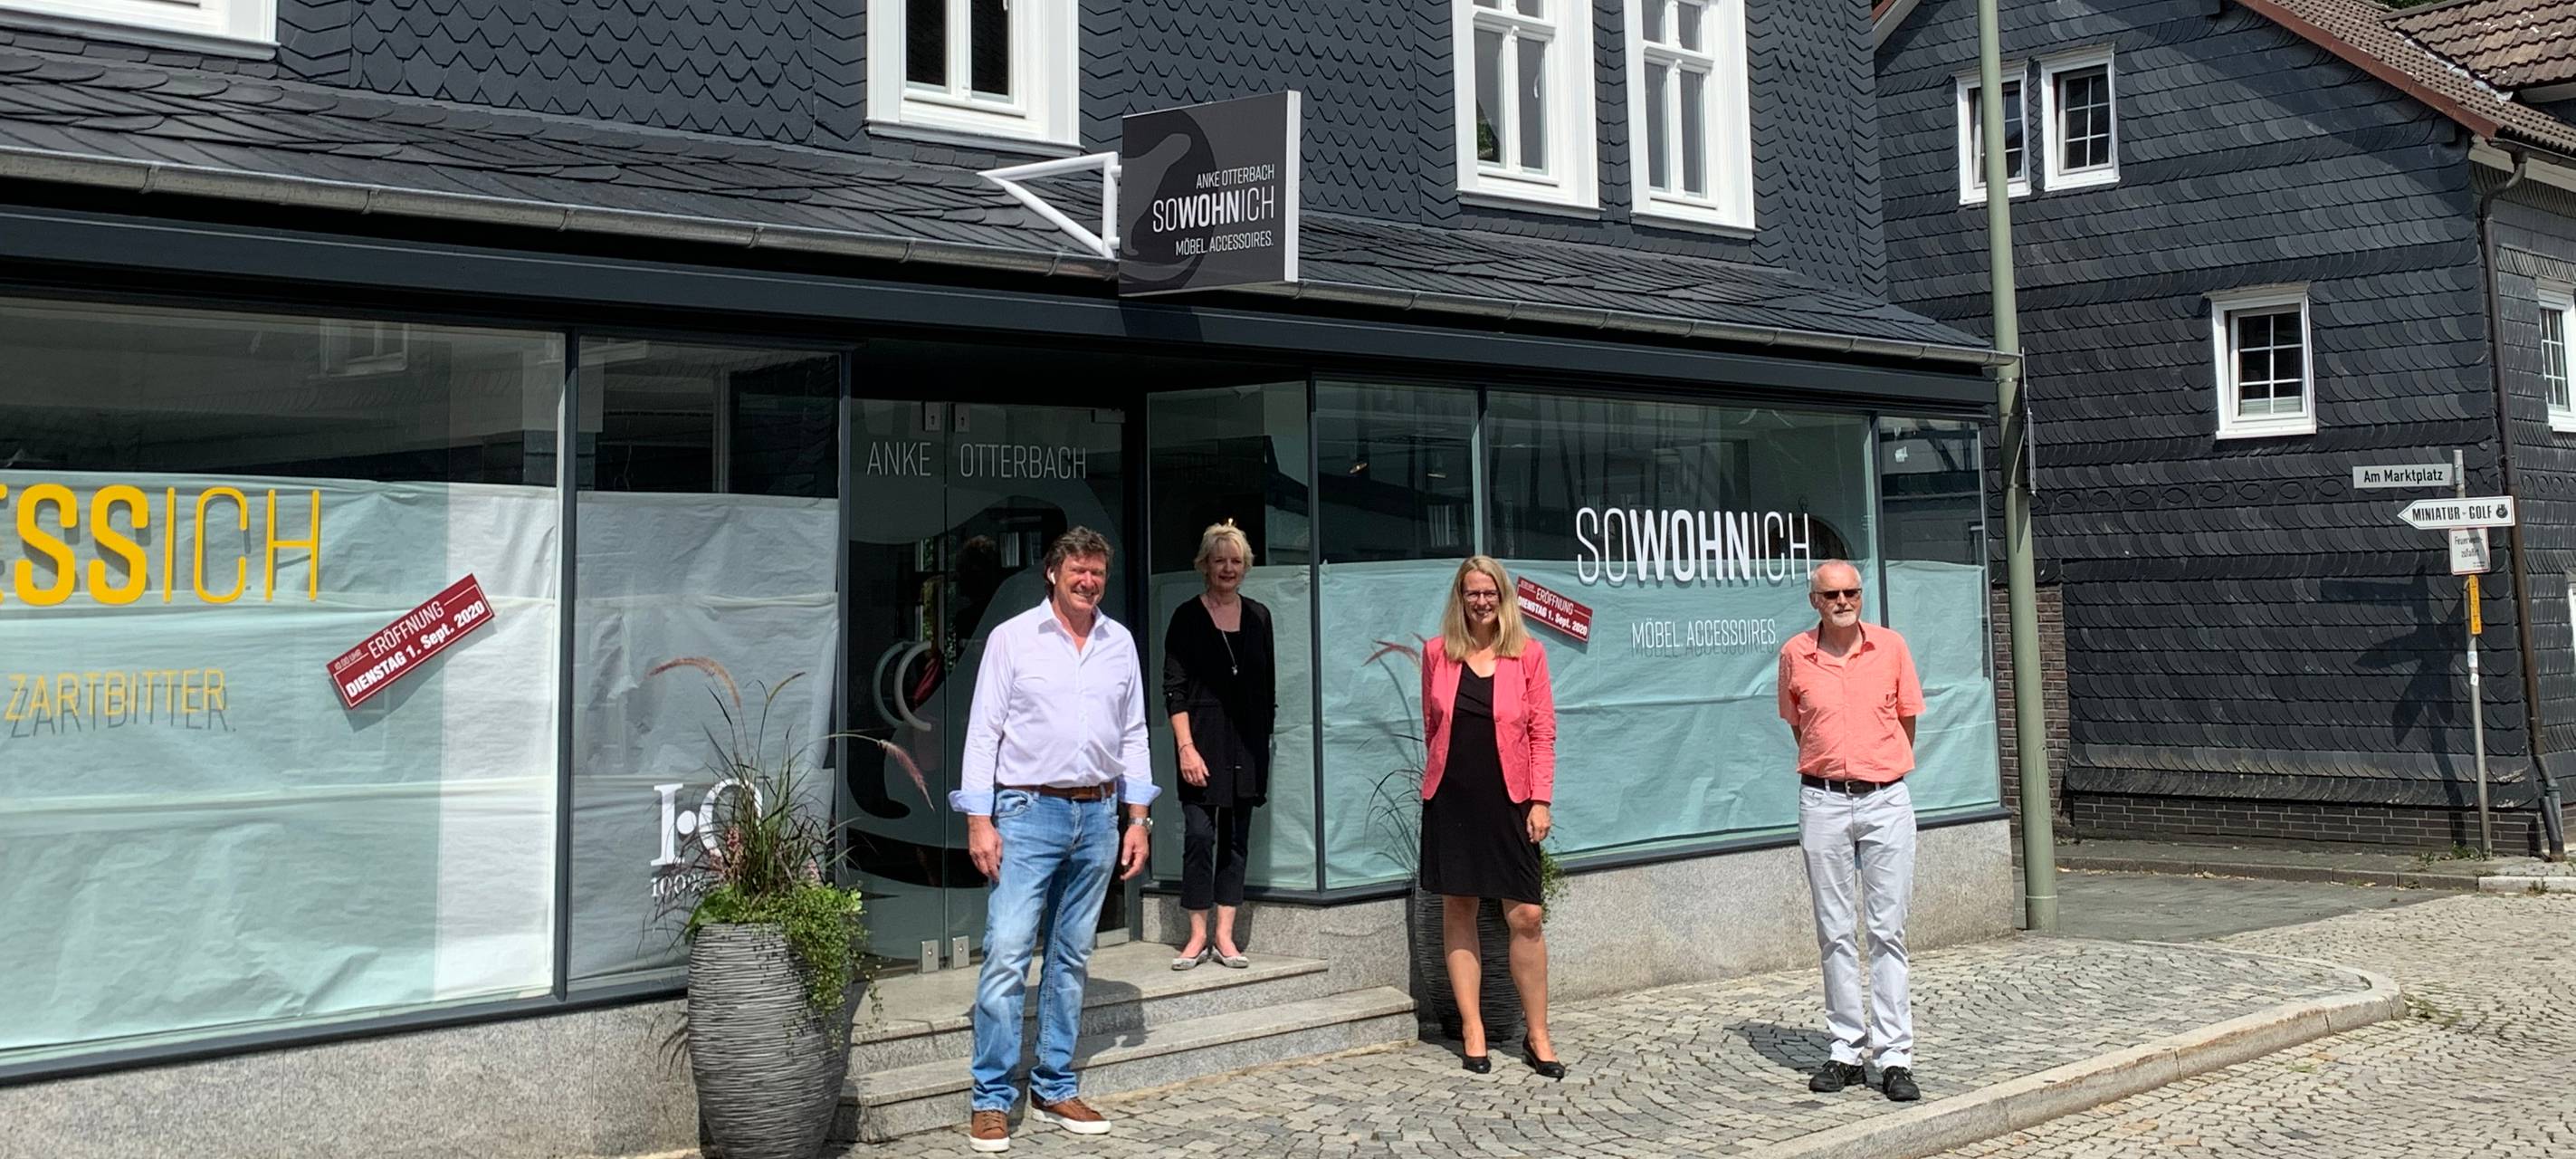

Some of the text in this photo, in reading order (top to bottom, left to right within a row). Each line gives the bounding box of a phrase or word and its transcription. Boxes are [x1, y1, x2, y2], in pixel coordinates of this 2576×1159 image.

[1196, 164, 1274, 189] ANKE OTTERBACH
[1153, 185, 1274, 233] SOWOHNICH
[1176, 230, 1274, 256] MÖBEL. ACCESSOIRES.
[866, 442, 1086, 479] ANKE OTTERBACH
[2363, 468, 2443, 484] Am Marktplatz
[2469, 504, 2492, 520] GOLF
[0, 484, 320, 607] SSICH
[1576, 507, 1811, 582] SOWOHNICH
[1518, 596, 1547, 618] DIENSTAG
[1555, 613, 1570, 628] Sept.
[1571, 620, 1588, 636] 2020
[1536, 588, 1574, 615] ERÖFFNUNG
[367, 600, 444, 658] ERÖFFNUNG
[1686, 618, 1779, 647] ACCESSOIRES.
[345, 600, 486, 697] DIENSTAG 1. Sept. 2020
